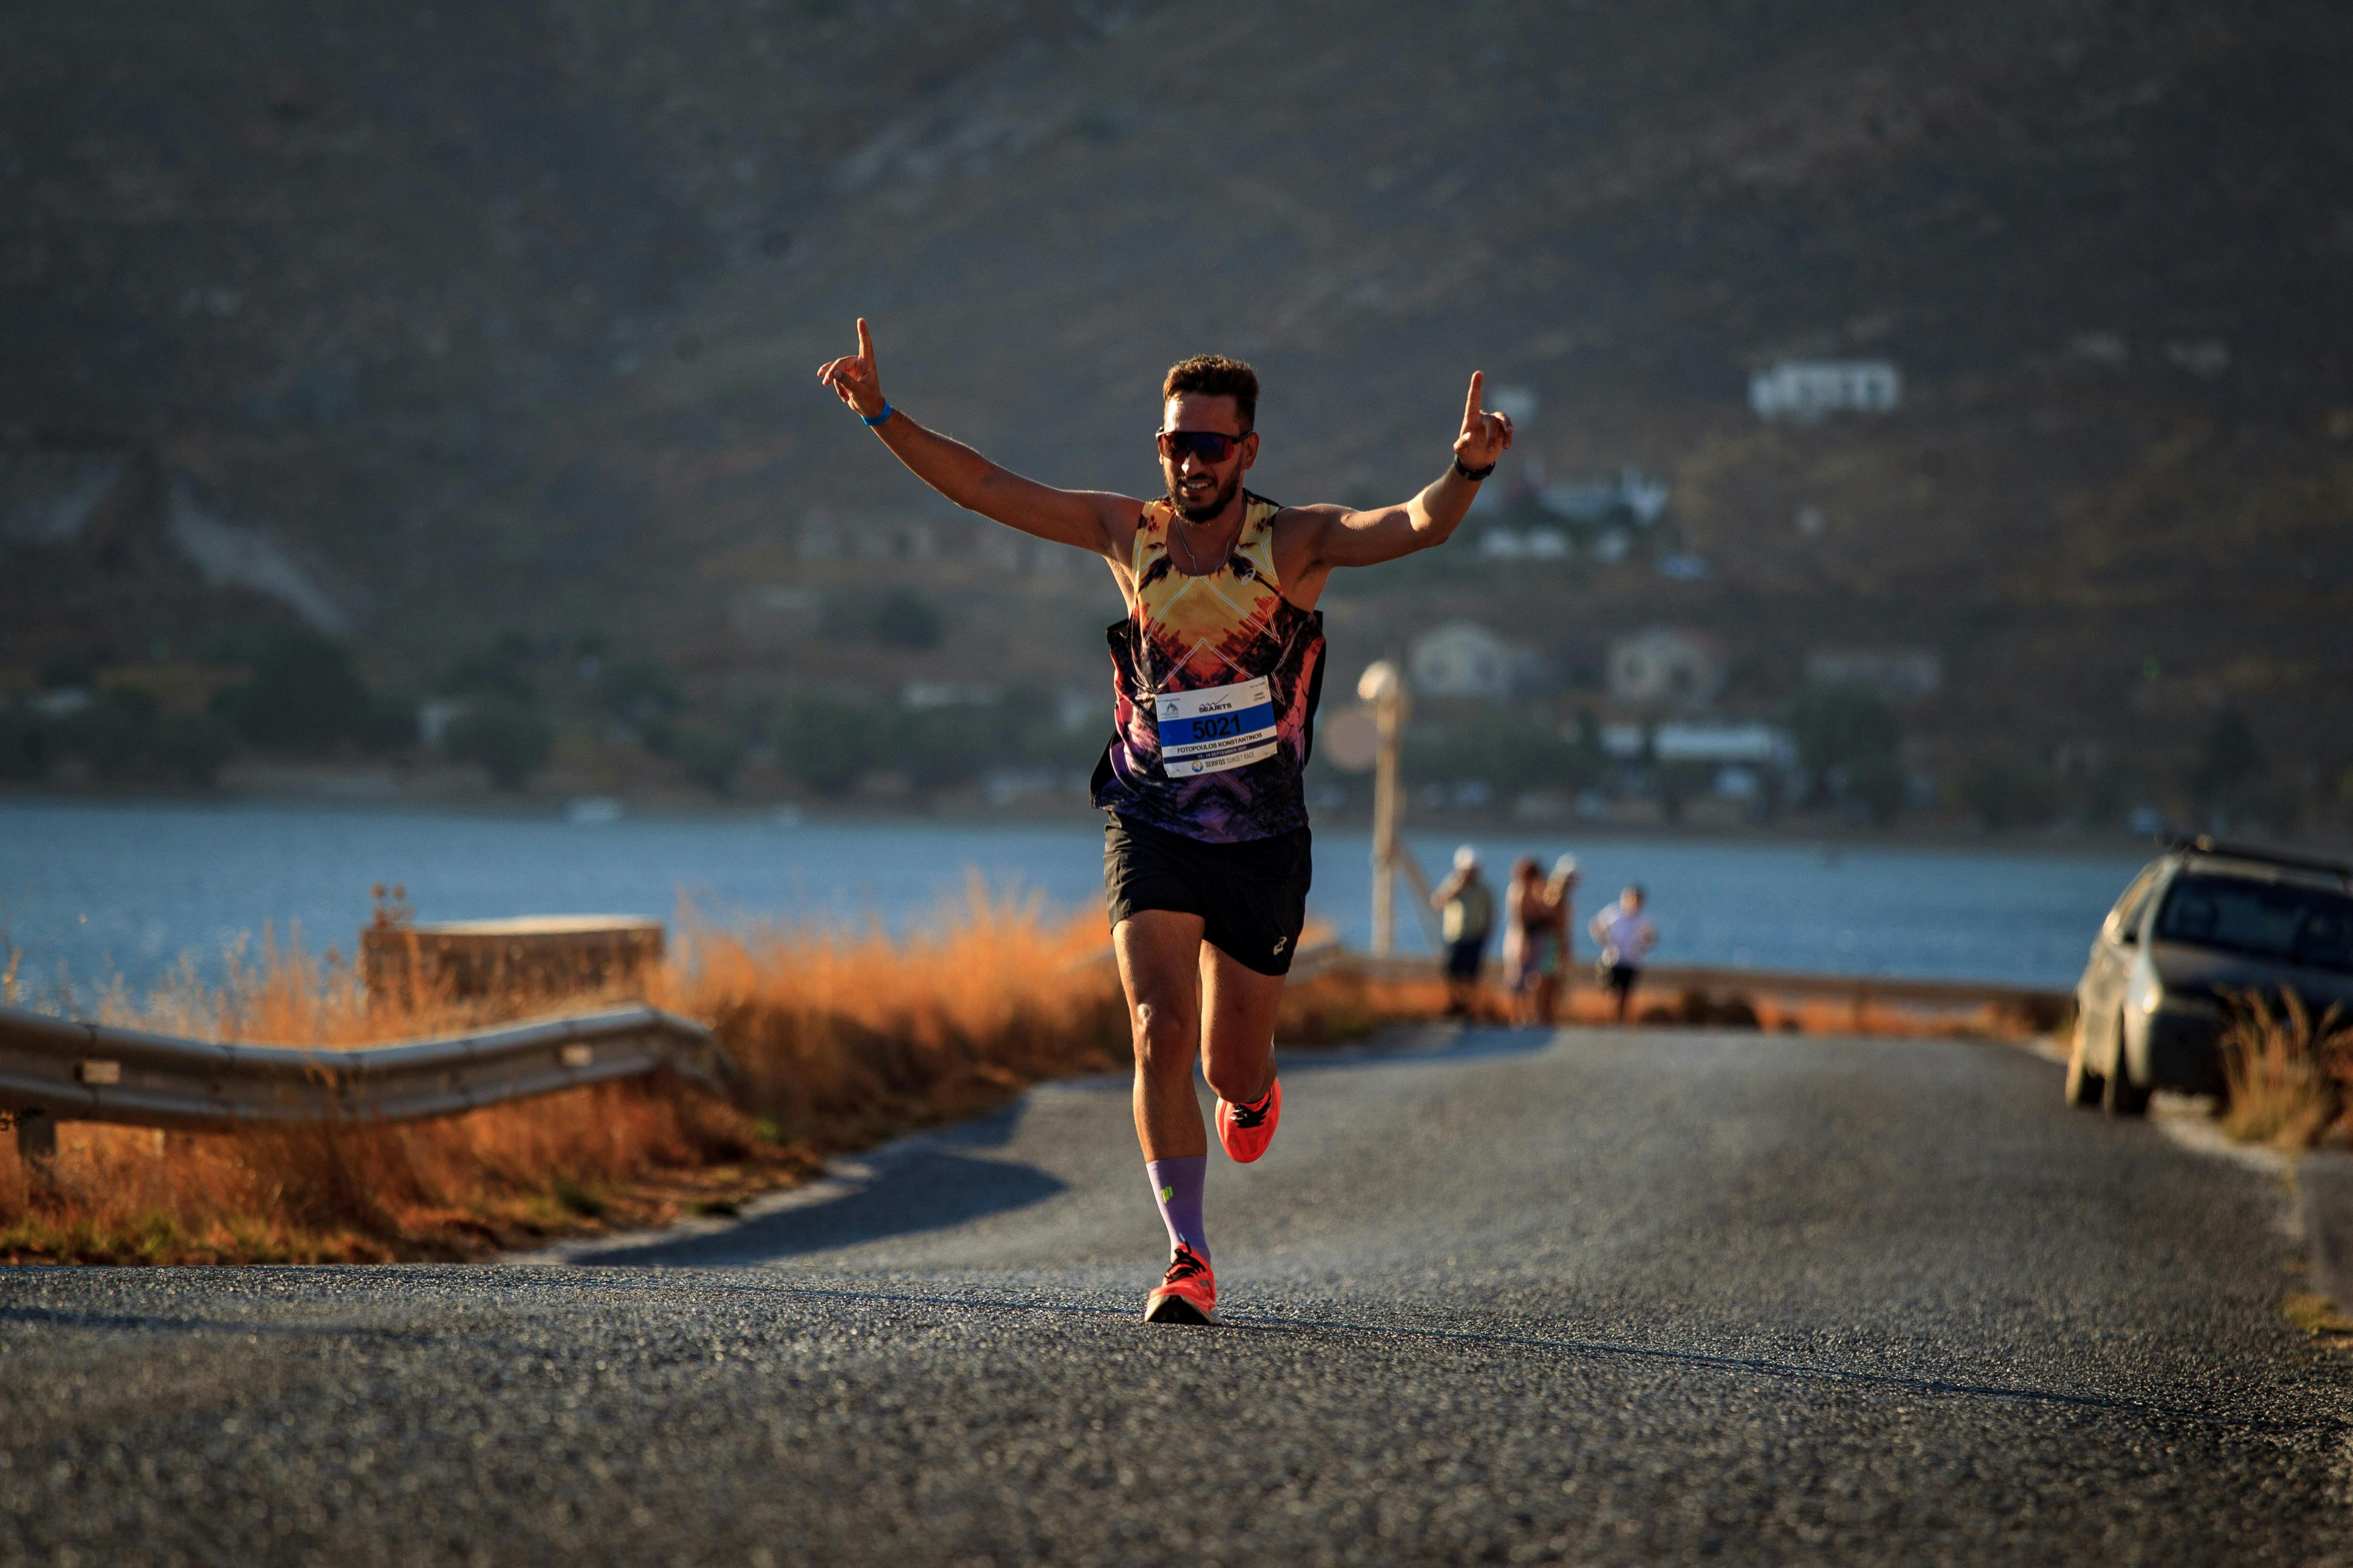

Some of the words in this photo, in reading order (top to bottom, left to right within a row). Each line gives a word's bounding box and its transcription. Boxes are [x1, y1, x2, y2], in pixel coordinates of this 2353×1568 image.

[1199, 702, 1232, 713] SEAJETS
[1192, 714, 1241, 739] 5021
[1177, 742, 1217, 753] FOTOPOULOS
[1218, 733, 1262, 747] KONSTANTINOS
[1211, 748, 1237, 756] SEPTEMBER
[1205, 758, 1226, 768] SERIFOS
[1226, 755, 1243, 764] SUNSET
